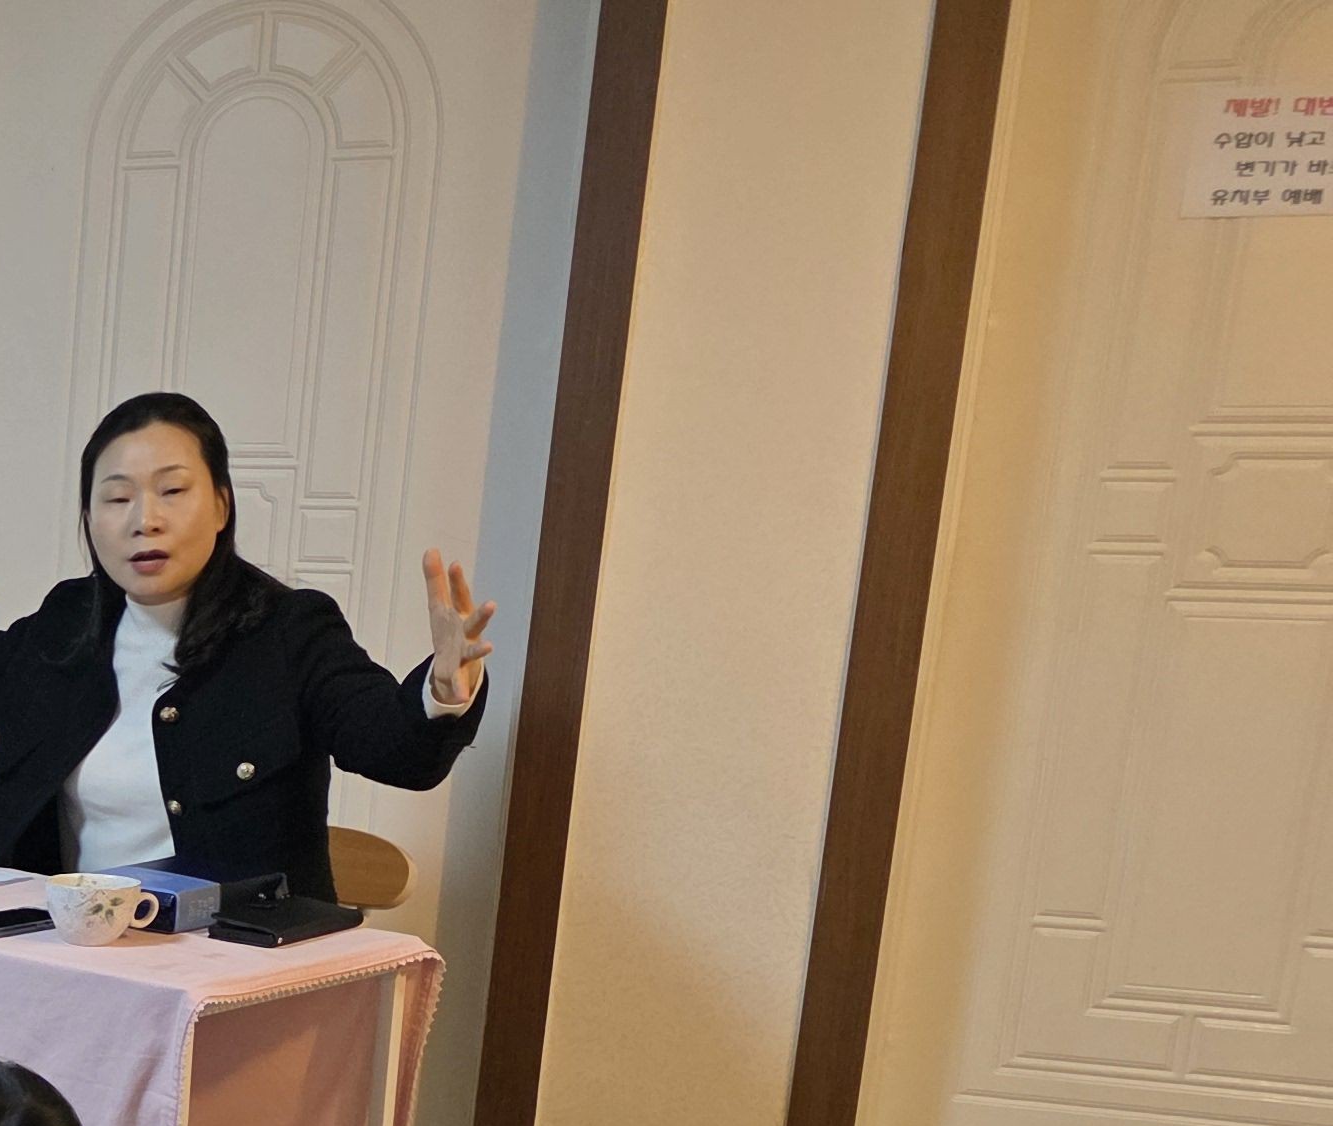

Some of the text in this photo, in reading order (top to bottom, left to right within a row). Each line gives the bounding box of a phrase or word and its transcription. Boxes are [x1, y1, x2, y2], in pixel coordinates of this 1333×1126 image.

[1213, 131, 1326, 149] 수압이 낮고
[1235, 159, 1333, 177] 변기가 바
